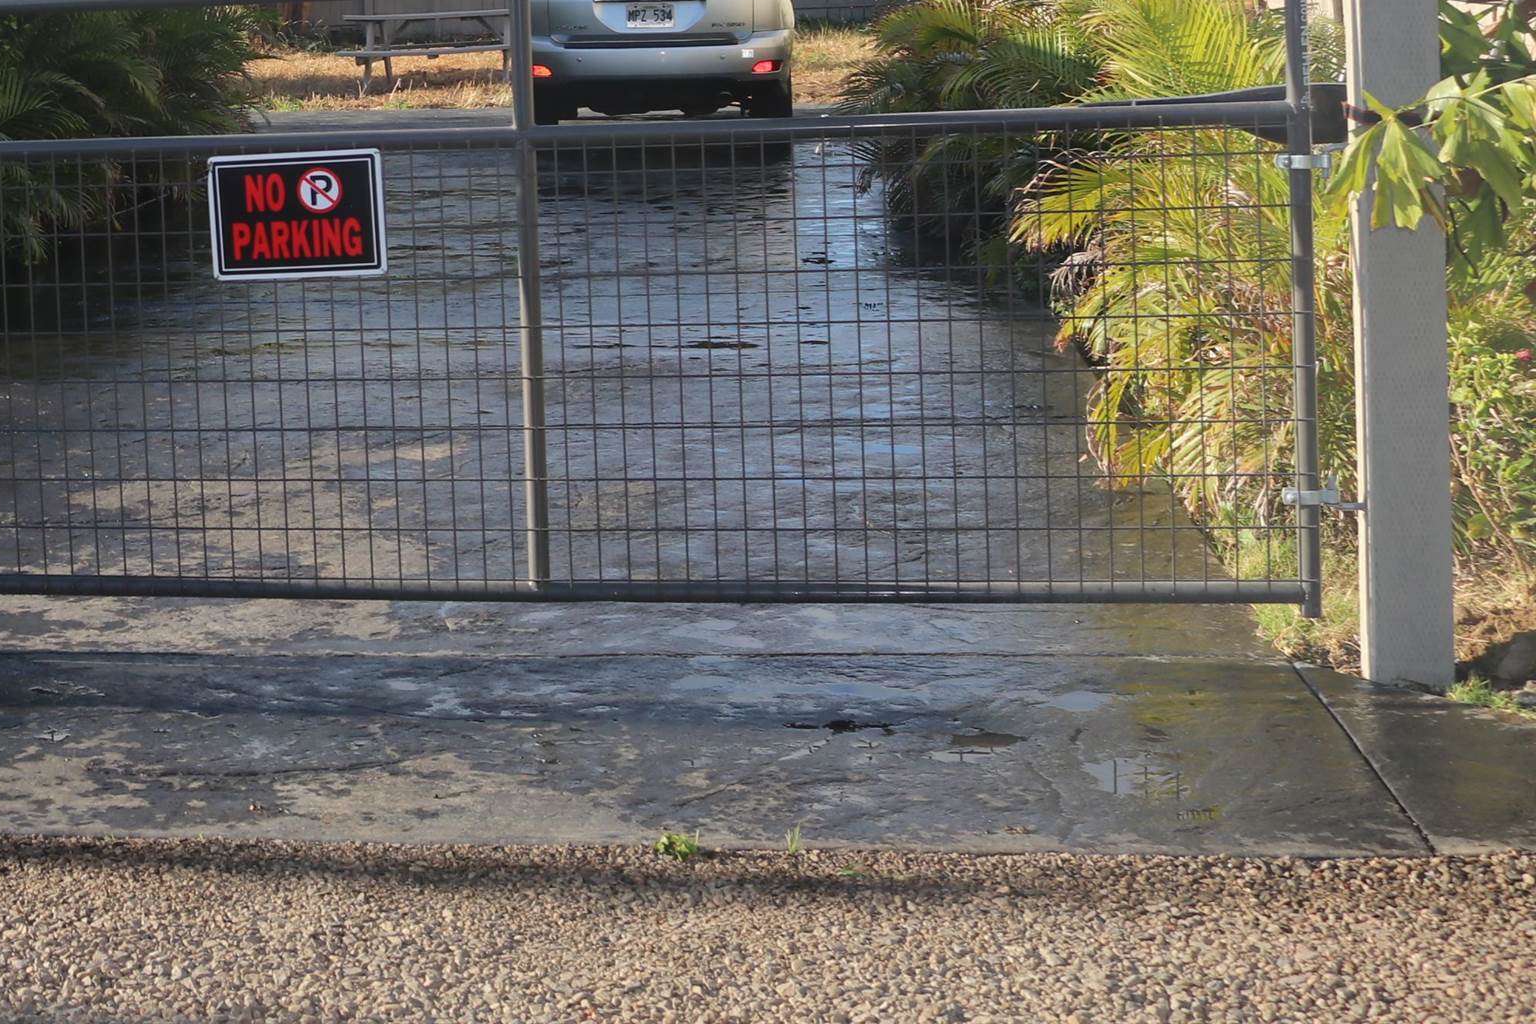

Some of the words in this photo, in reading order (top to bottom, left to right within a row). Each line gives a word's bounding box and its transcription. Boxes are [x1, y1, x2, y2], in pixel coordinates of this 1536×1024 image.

[627, 9, 647, 22] MPZ
[244, 172, 287, 213] NO
[231, 216, 364, 261] PARKING
